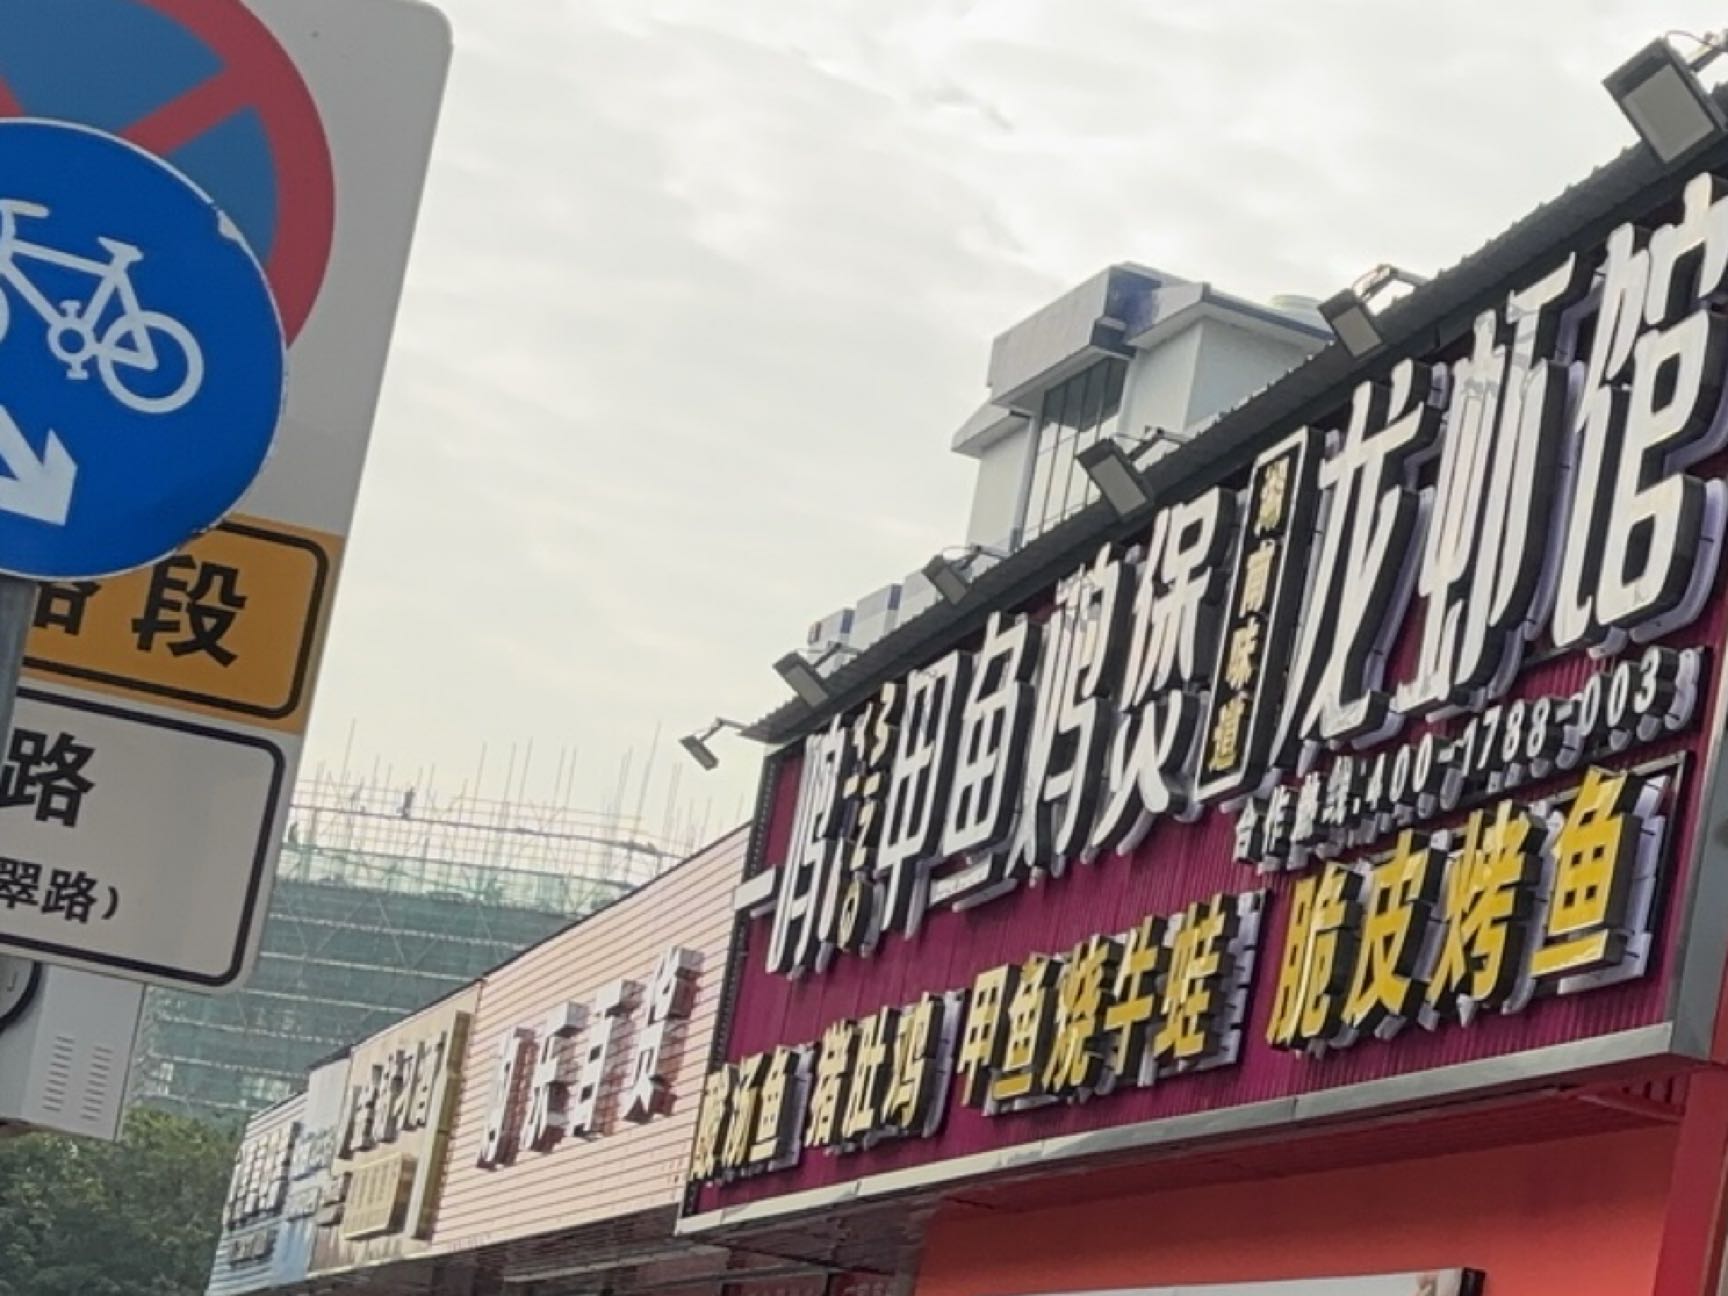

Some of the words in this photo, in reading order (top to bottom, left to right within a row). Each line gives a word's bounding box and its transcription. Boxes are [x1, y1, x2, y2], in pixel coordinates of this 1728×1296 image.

[877, 488, 1222, 932] 甲鱼鸡煲
[958, 895, 1230, 1107] 甲鱼烧牛蛙
[1267, 766, 1628, 1045] 脆皮烤鱼
[805, 992, 936, 1149] 猪肚鸡
